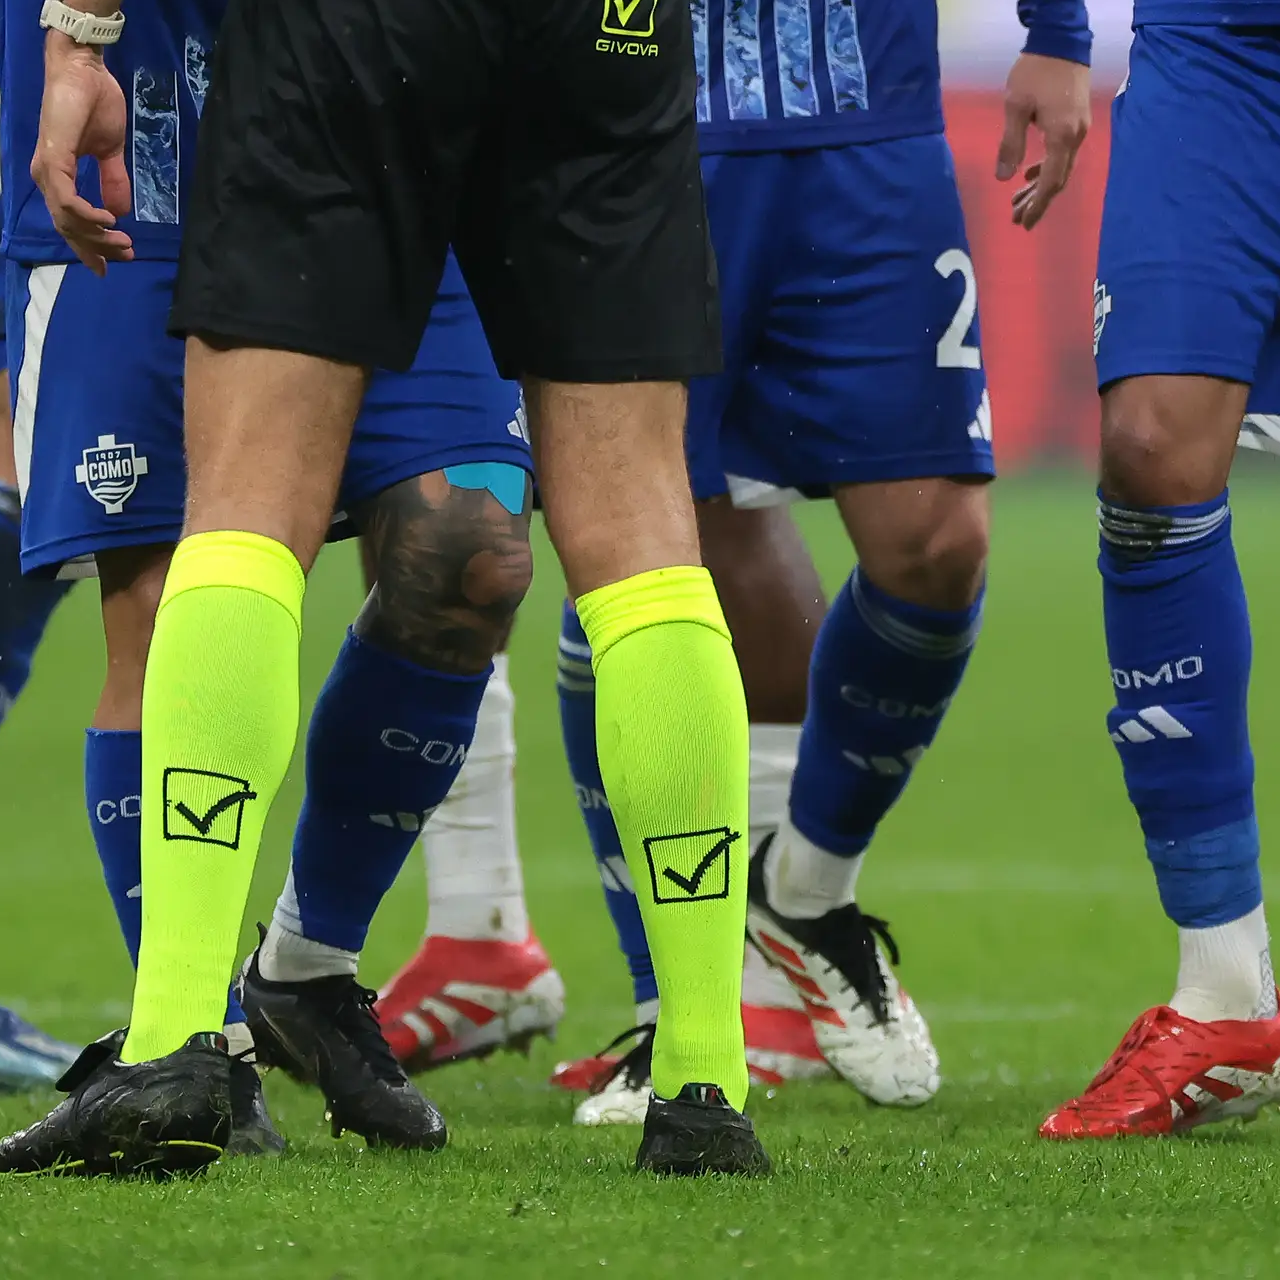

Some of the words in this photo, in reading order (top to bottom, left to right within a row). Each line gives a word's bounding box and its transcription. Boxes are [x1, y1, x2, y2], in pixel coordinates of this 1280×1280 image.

[595, 38, 659, 58] GIVOVA
[88, 458, 132, 481] COMO
[1111, 655, 1203, 689] OMO
